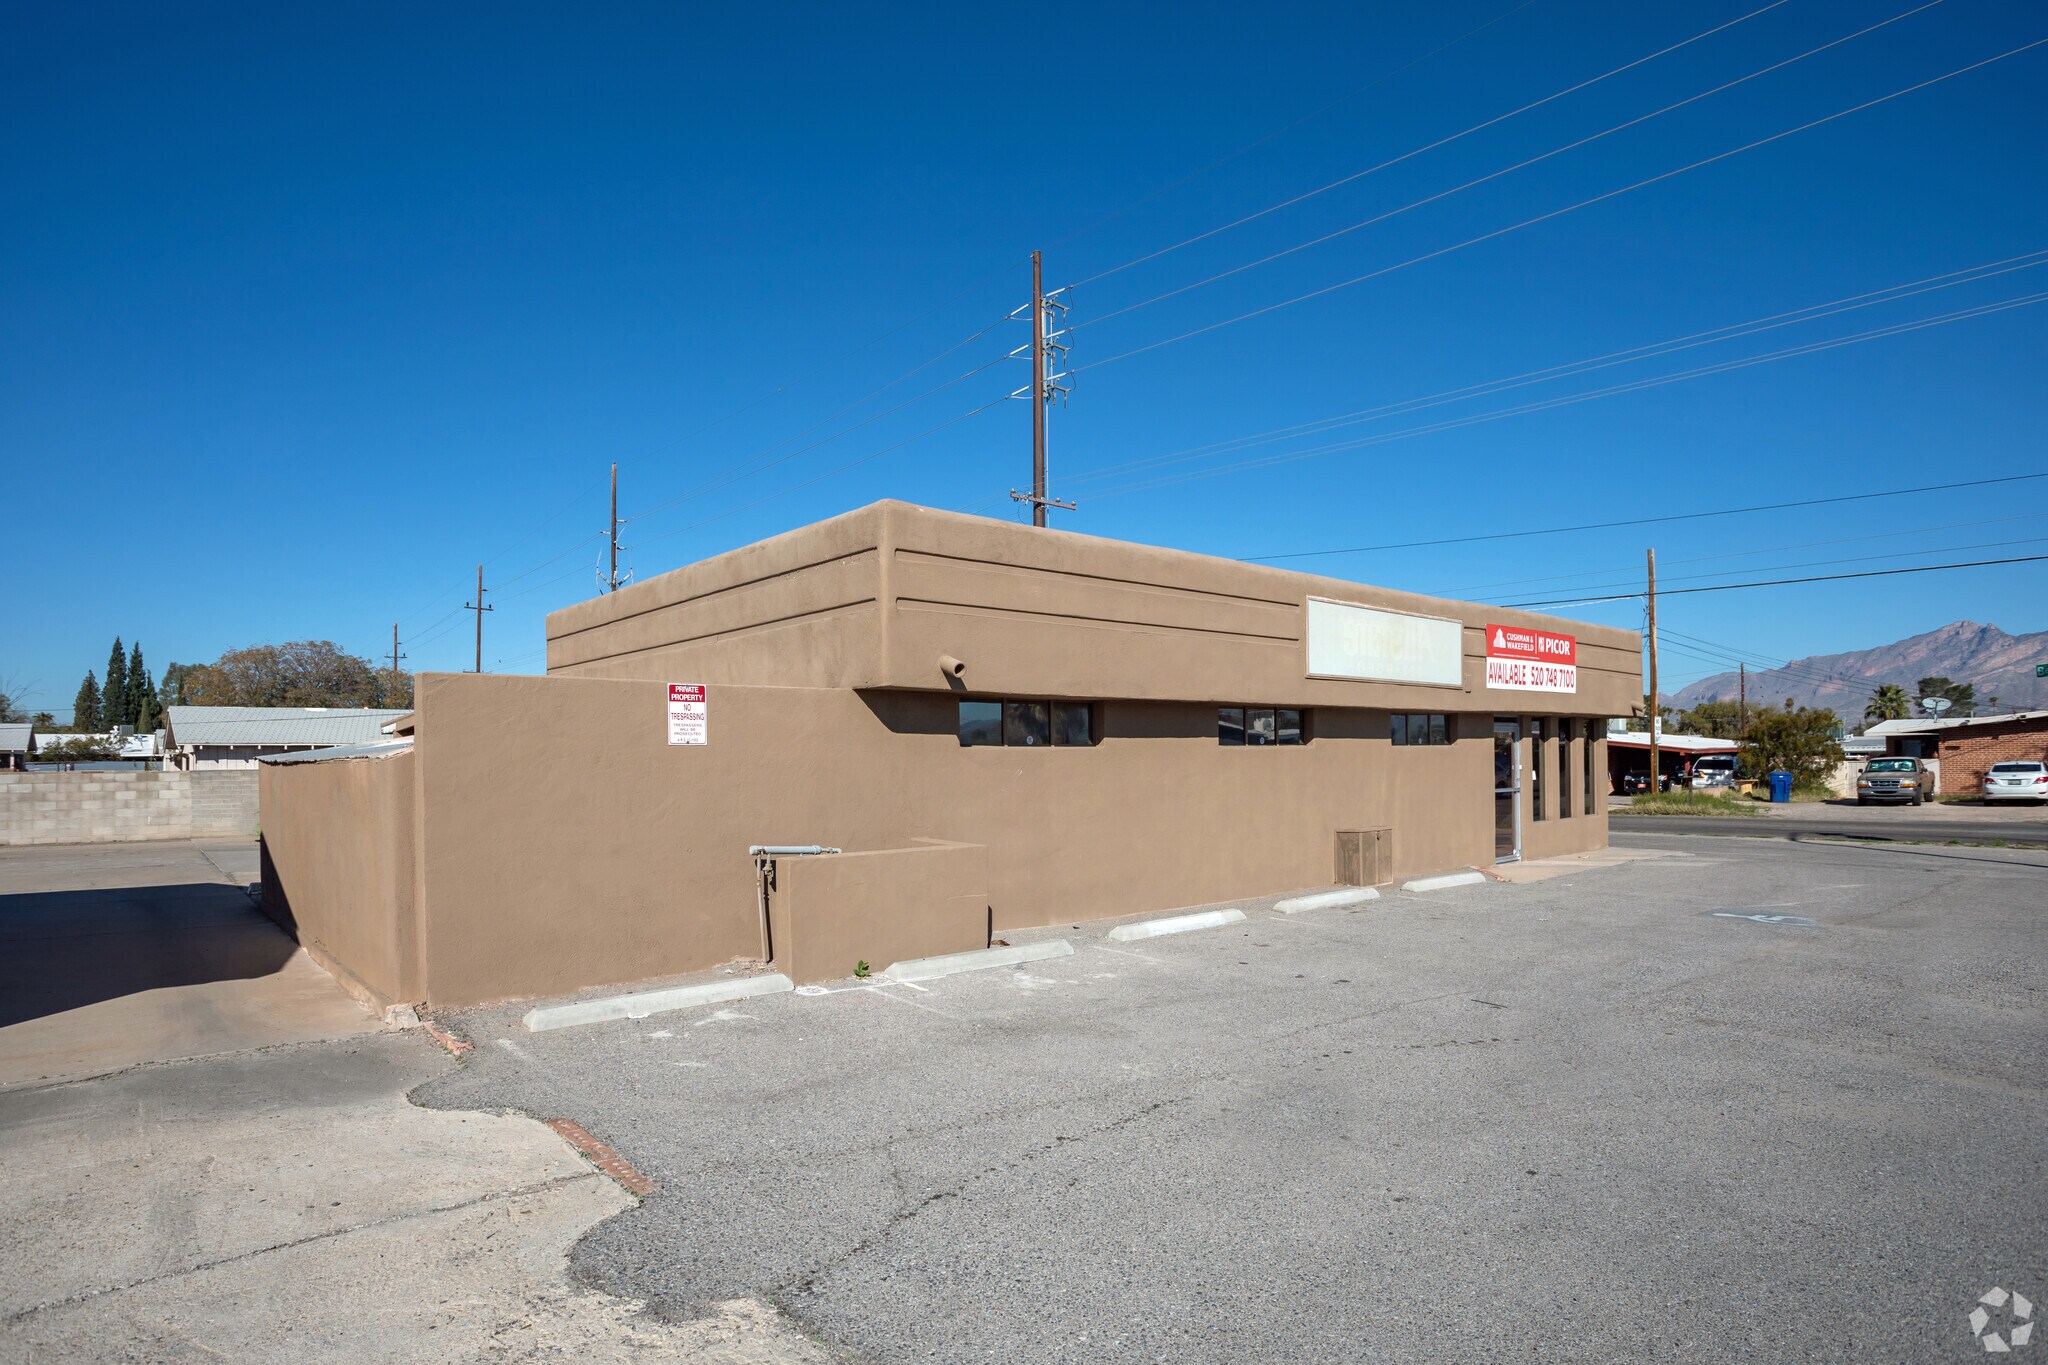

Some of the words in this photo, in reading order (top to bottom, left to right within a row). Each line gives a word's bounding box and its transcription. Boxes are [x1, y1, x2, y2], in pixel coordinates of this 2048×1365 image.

[1506, 633, 1529, 643] CUSHMAN
[1507, 642, 1534, 652] WAKEFIELD
[1546, 638, 1570, 655] PICOR
[1488, 662, 1526, 685] AVAILABLE
[1531, 666, 1544, 686] 520
[1546, 668, 1558, 687] 748
[1560, 669, 1574, 688] 7100
